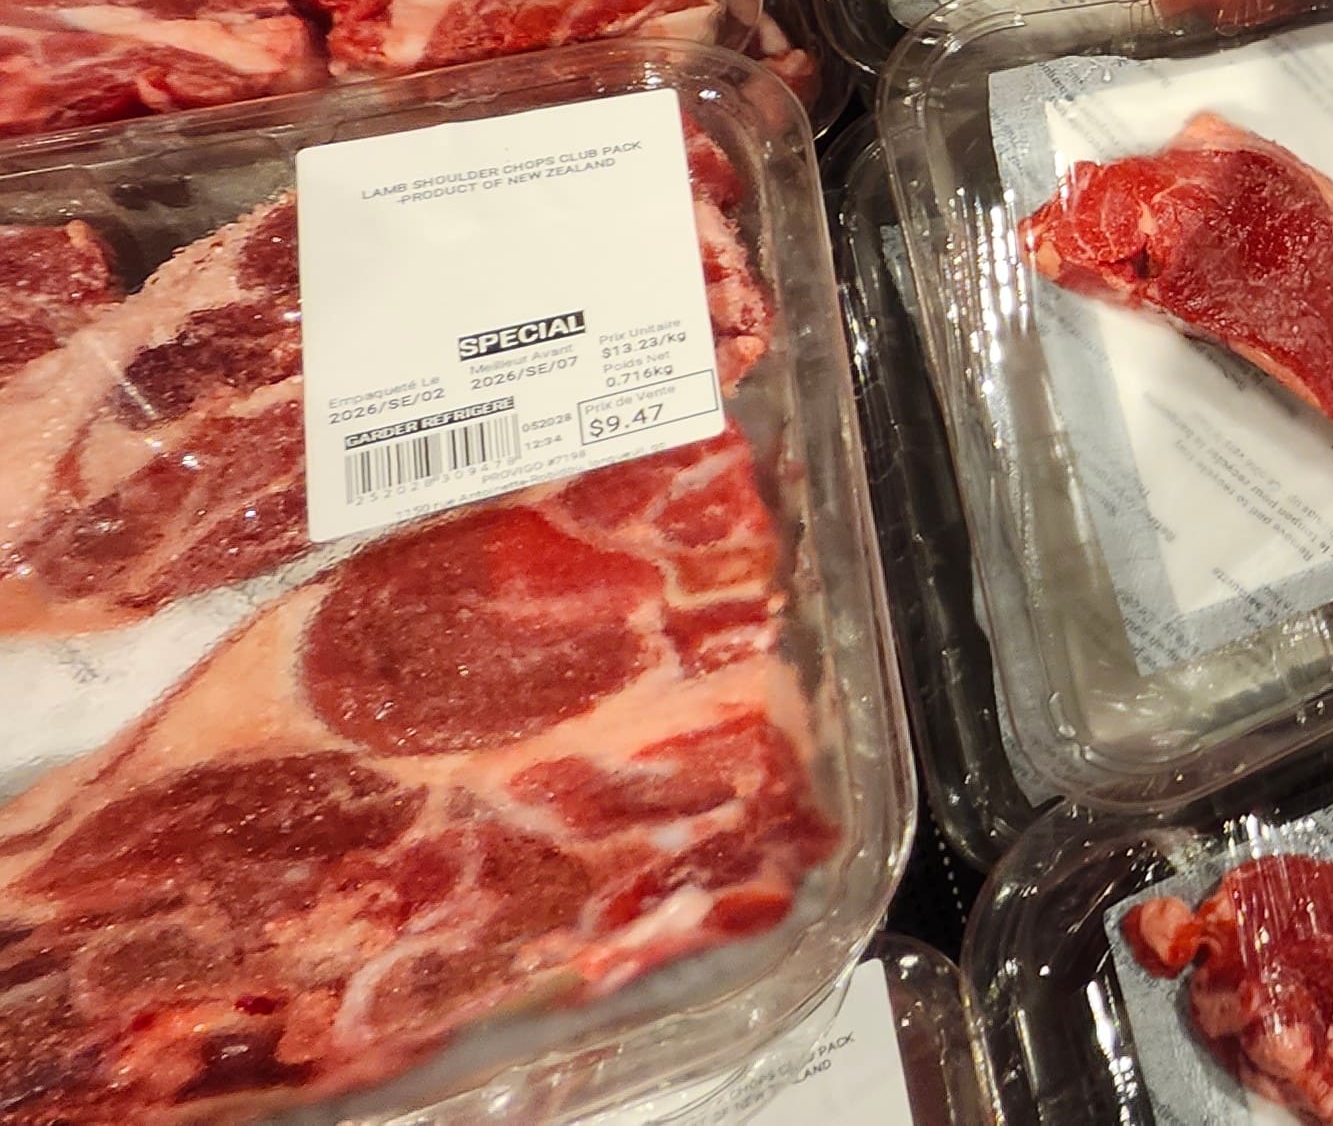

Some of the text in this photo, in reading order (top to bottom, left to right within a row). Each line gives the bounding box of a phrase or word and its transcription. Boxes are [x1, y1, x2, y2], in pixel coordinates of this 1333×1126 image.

[362, 141, 642, 200] LAMB SHOULDER CHOPS CLUB PACK
[483, 177, 503, 191] OF
[508, 169, 542, 187] NEW
[546, 156, 616, 180] ZEALAND
[459, 313, 586, 360] SPECIAL
[601, 331, 687, 359] $13.23/kg
[471, 356, 580, 392] 2026/SE/07
[606, 364, 674, 389] 0.716kg
[330, 387, 446, 425] 2026/SE/02
[589, 404, 664, 438] $9.47
[345, 419, 419, 449] GARDER
